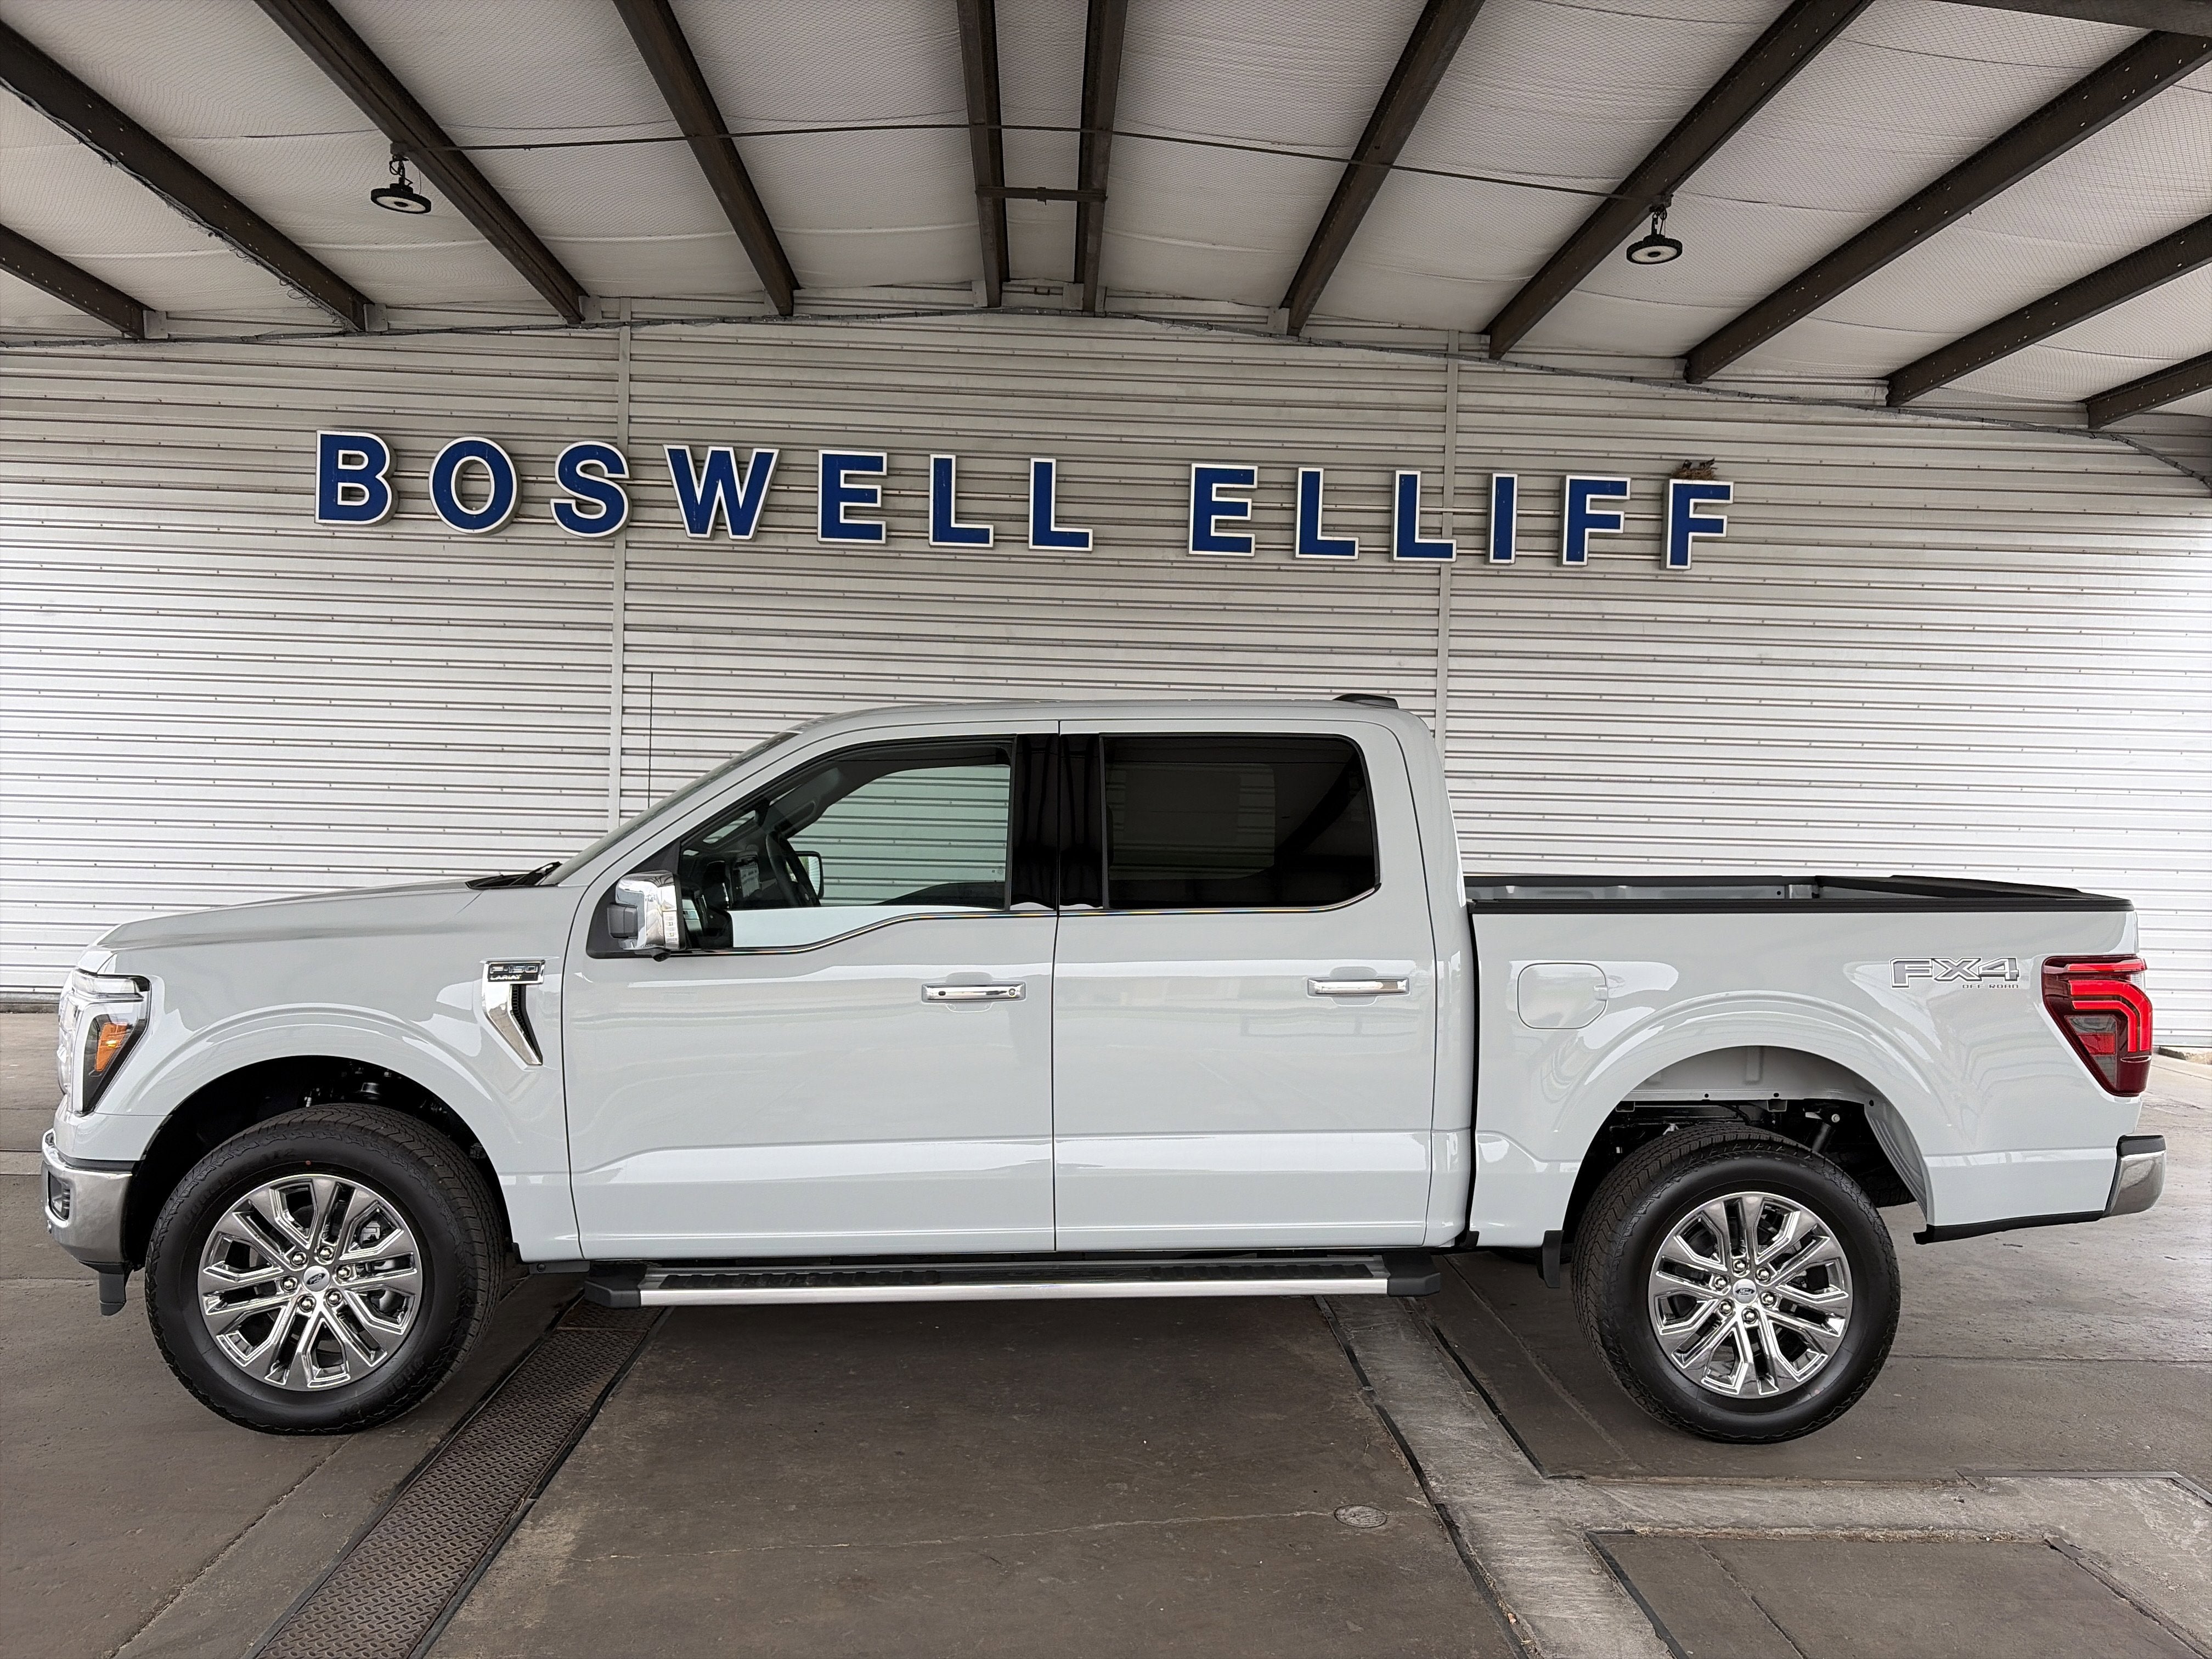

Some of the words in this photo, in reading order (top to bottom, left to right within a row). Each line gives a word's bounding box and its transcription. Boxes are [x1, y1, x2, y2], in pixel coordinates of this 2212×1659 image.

[314, 430, 1093, 552] BOSWELL
[1188, 464, 1734, 570] ELLIFF
[490, 965, 538, 974] F-150
[1889, 957, 2020, 989] FX4
